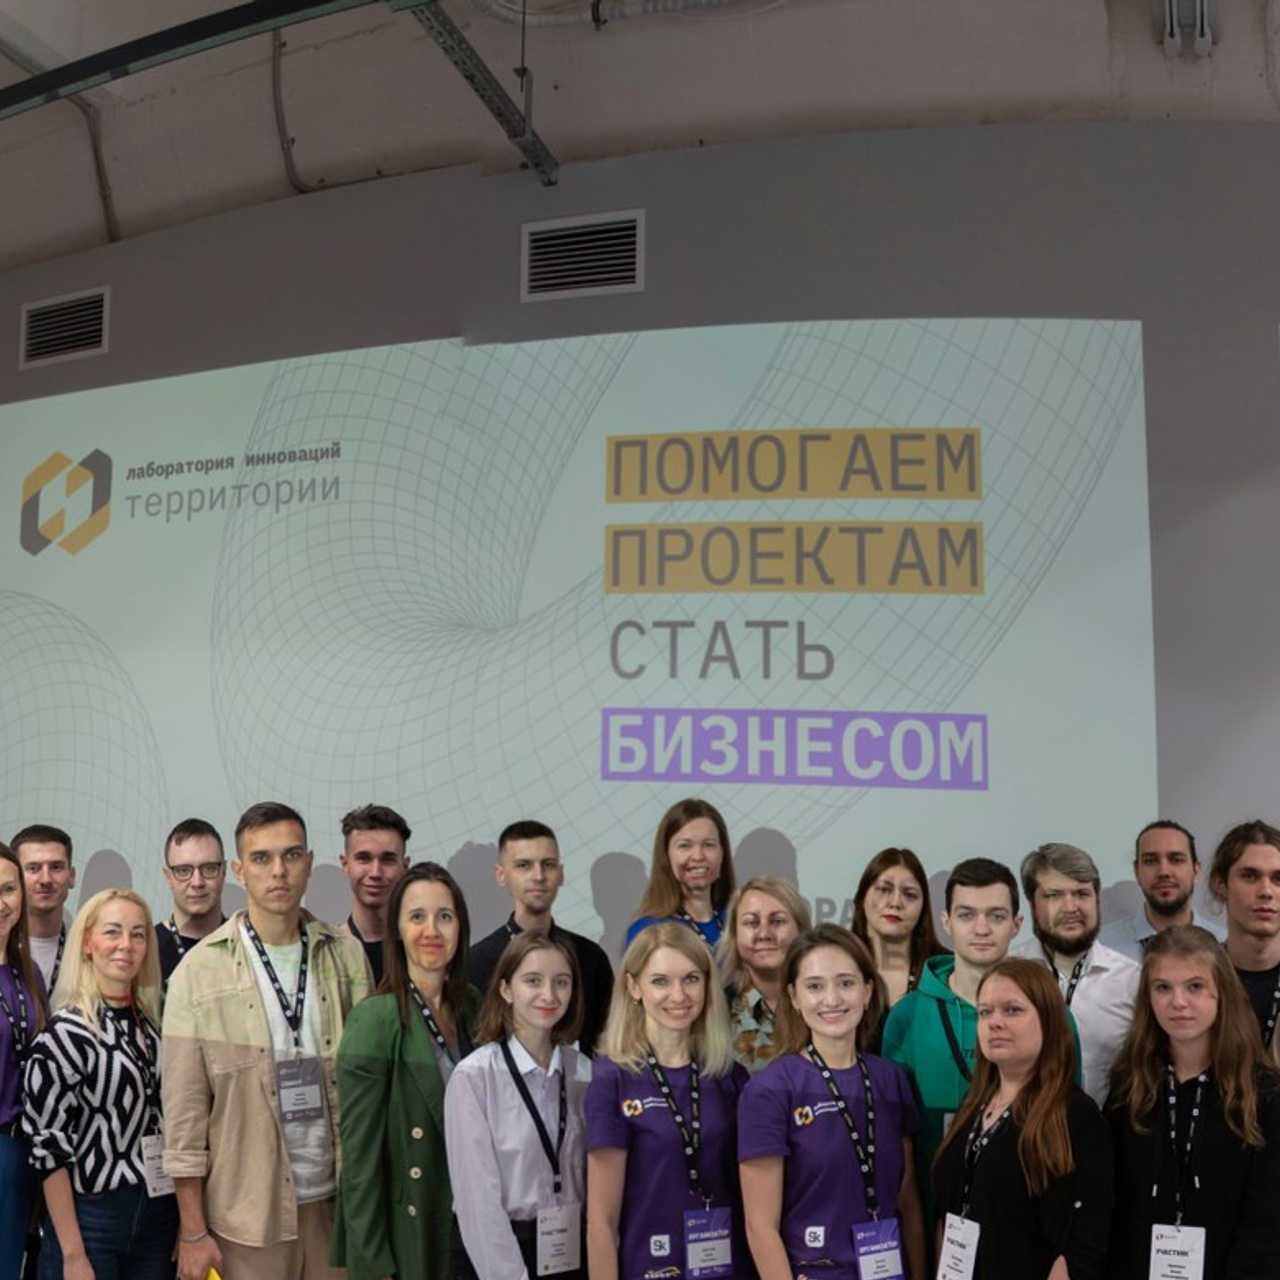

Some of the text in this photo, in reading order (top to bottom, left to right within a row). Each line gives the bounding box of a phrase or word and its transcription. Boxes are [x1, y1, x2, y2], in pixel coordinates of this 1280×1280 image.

[127, 442, 341, 480] лаборатория инноваций
[612, 434, 977, 495] ПОМОГАЕМ
[125, 476, 341, 522] территории
[611, 527, 979, 586] ПРОЕКТАМ
[609, 621, 834, 679] СТАТЬ
[608, 715, 983, 782] БИЗНЕСОМ
